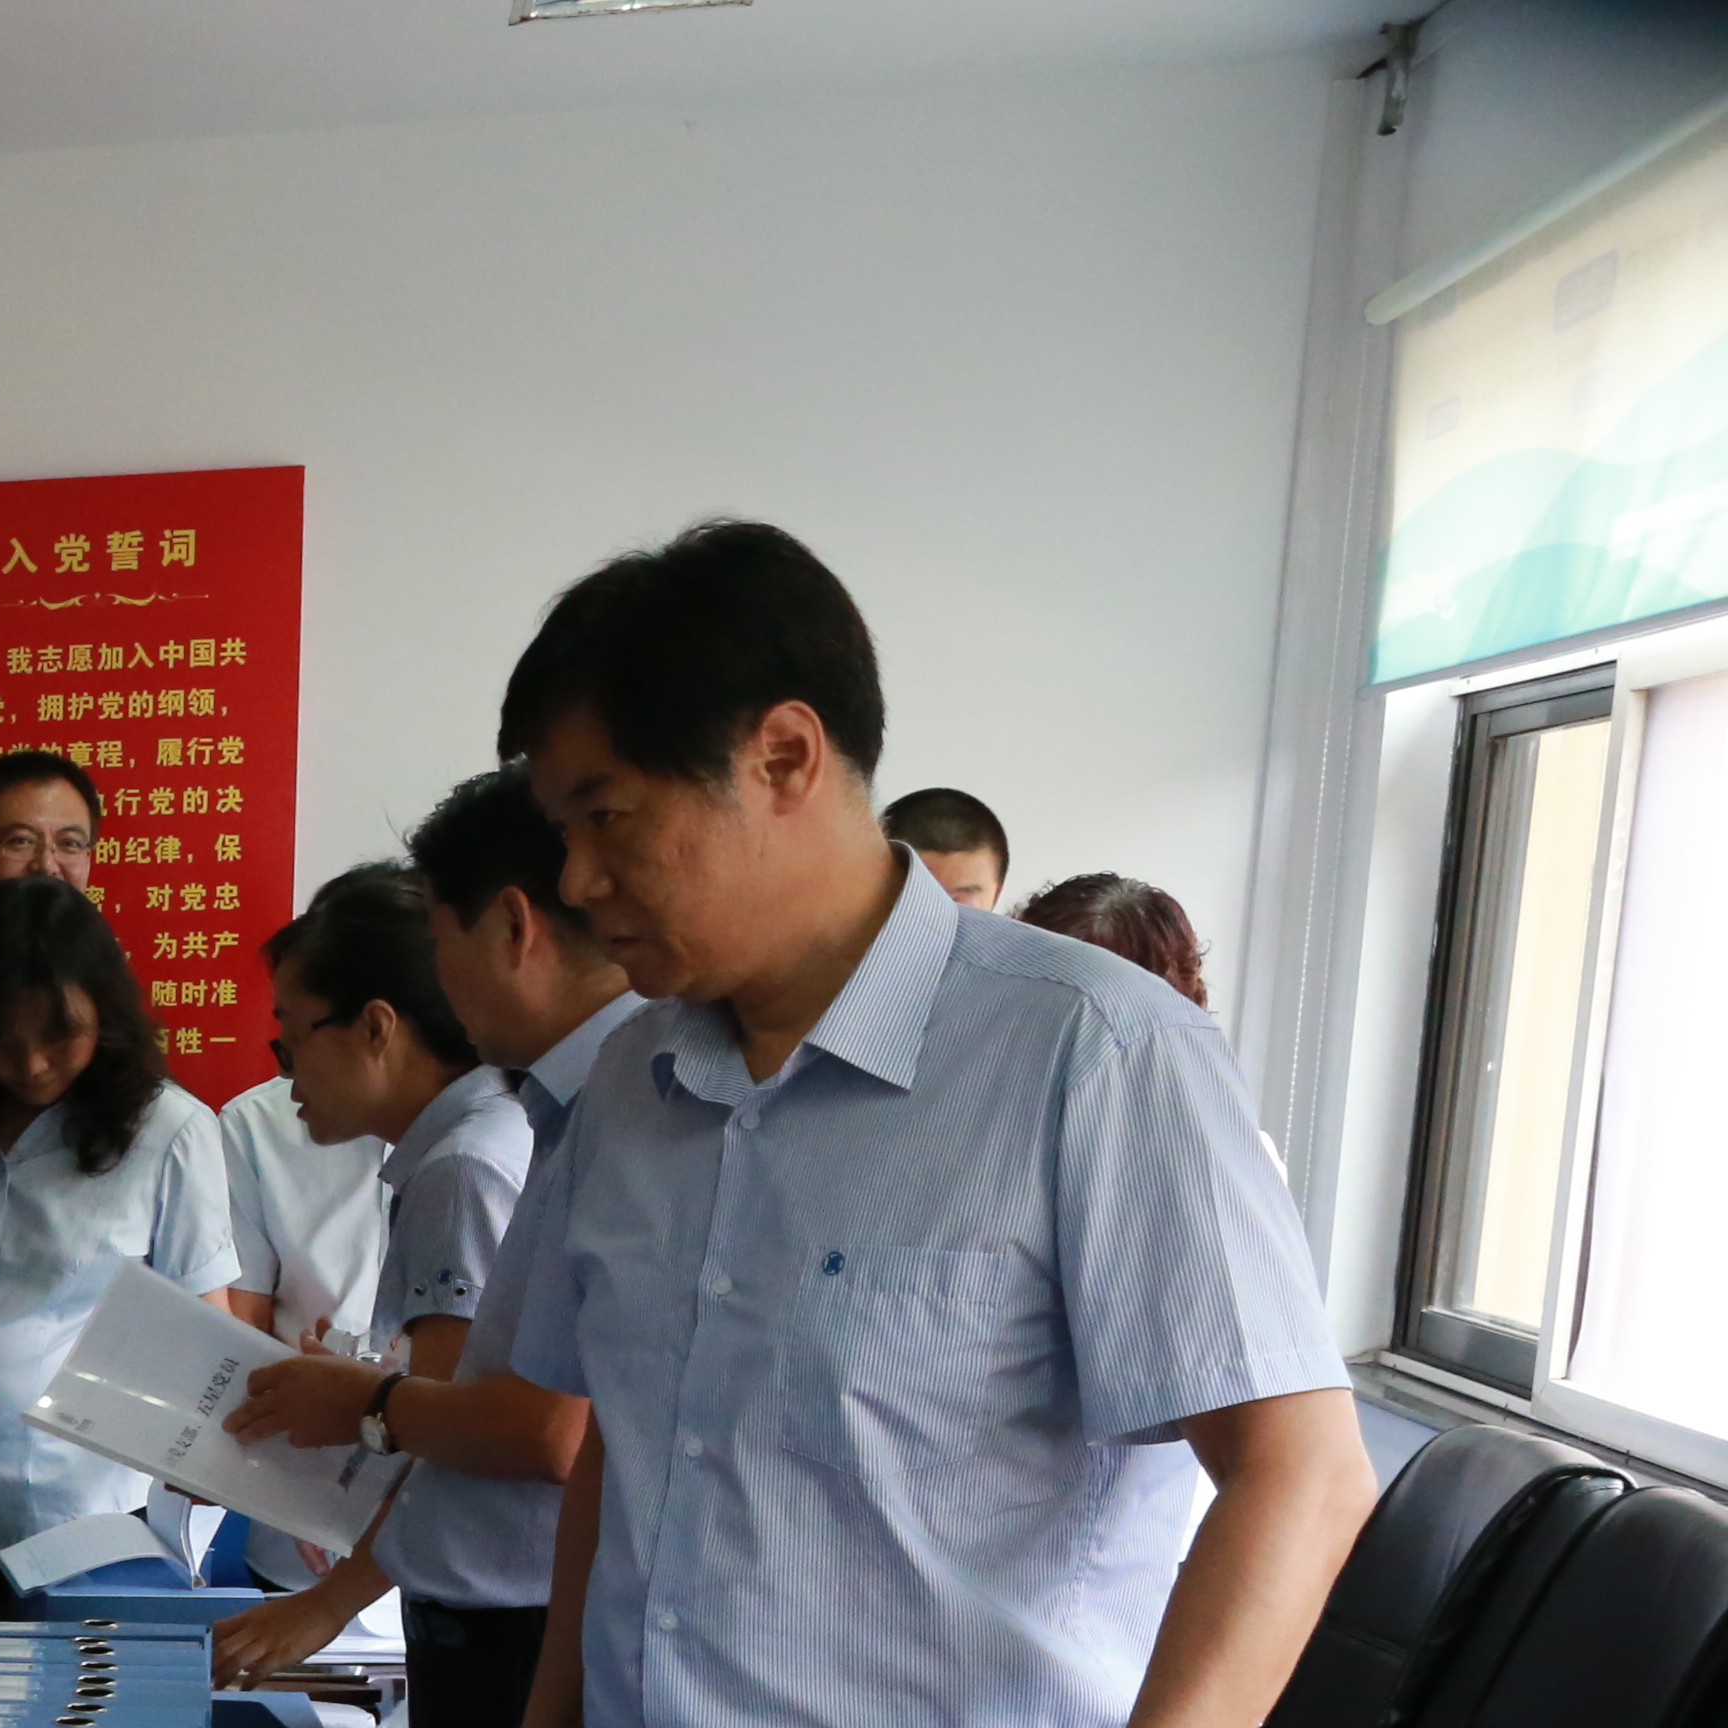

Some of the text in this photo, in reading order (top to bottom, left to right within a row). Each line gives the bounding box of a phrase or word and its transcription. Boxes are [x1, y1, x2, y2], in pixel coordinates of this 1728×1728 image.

[2, 529, 196, 573] 入党誓词
[6, 639, 246, 673] 我志愿加入中国共
